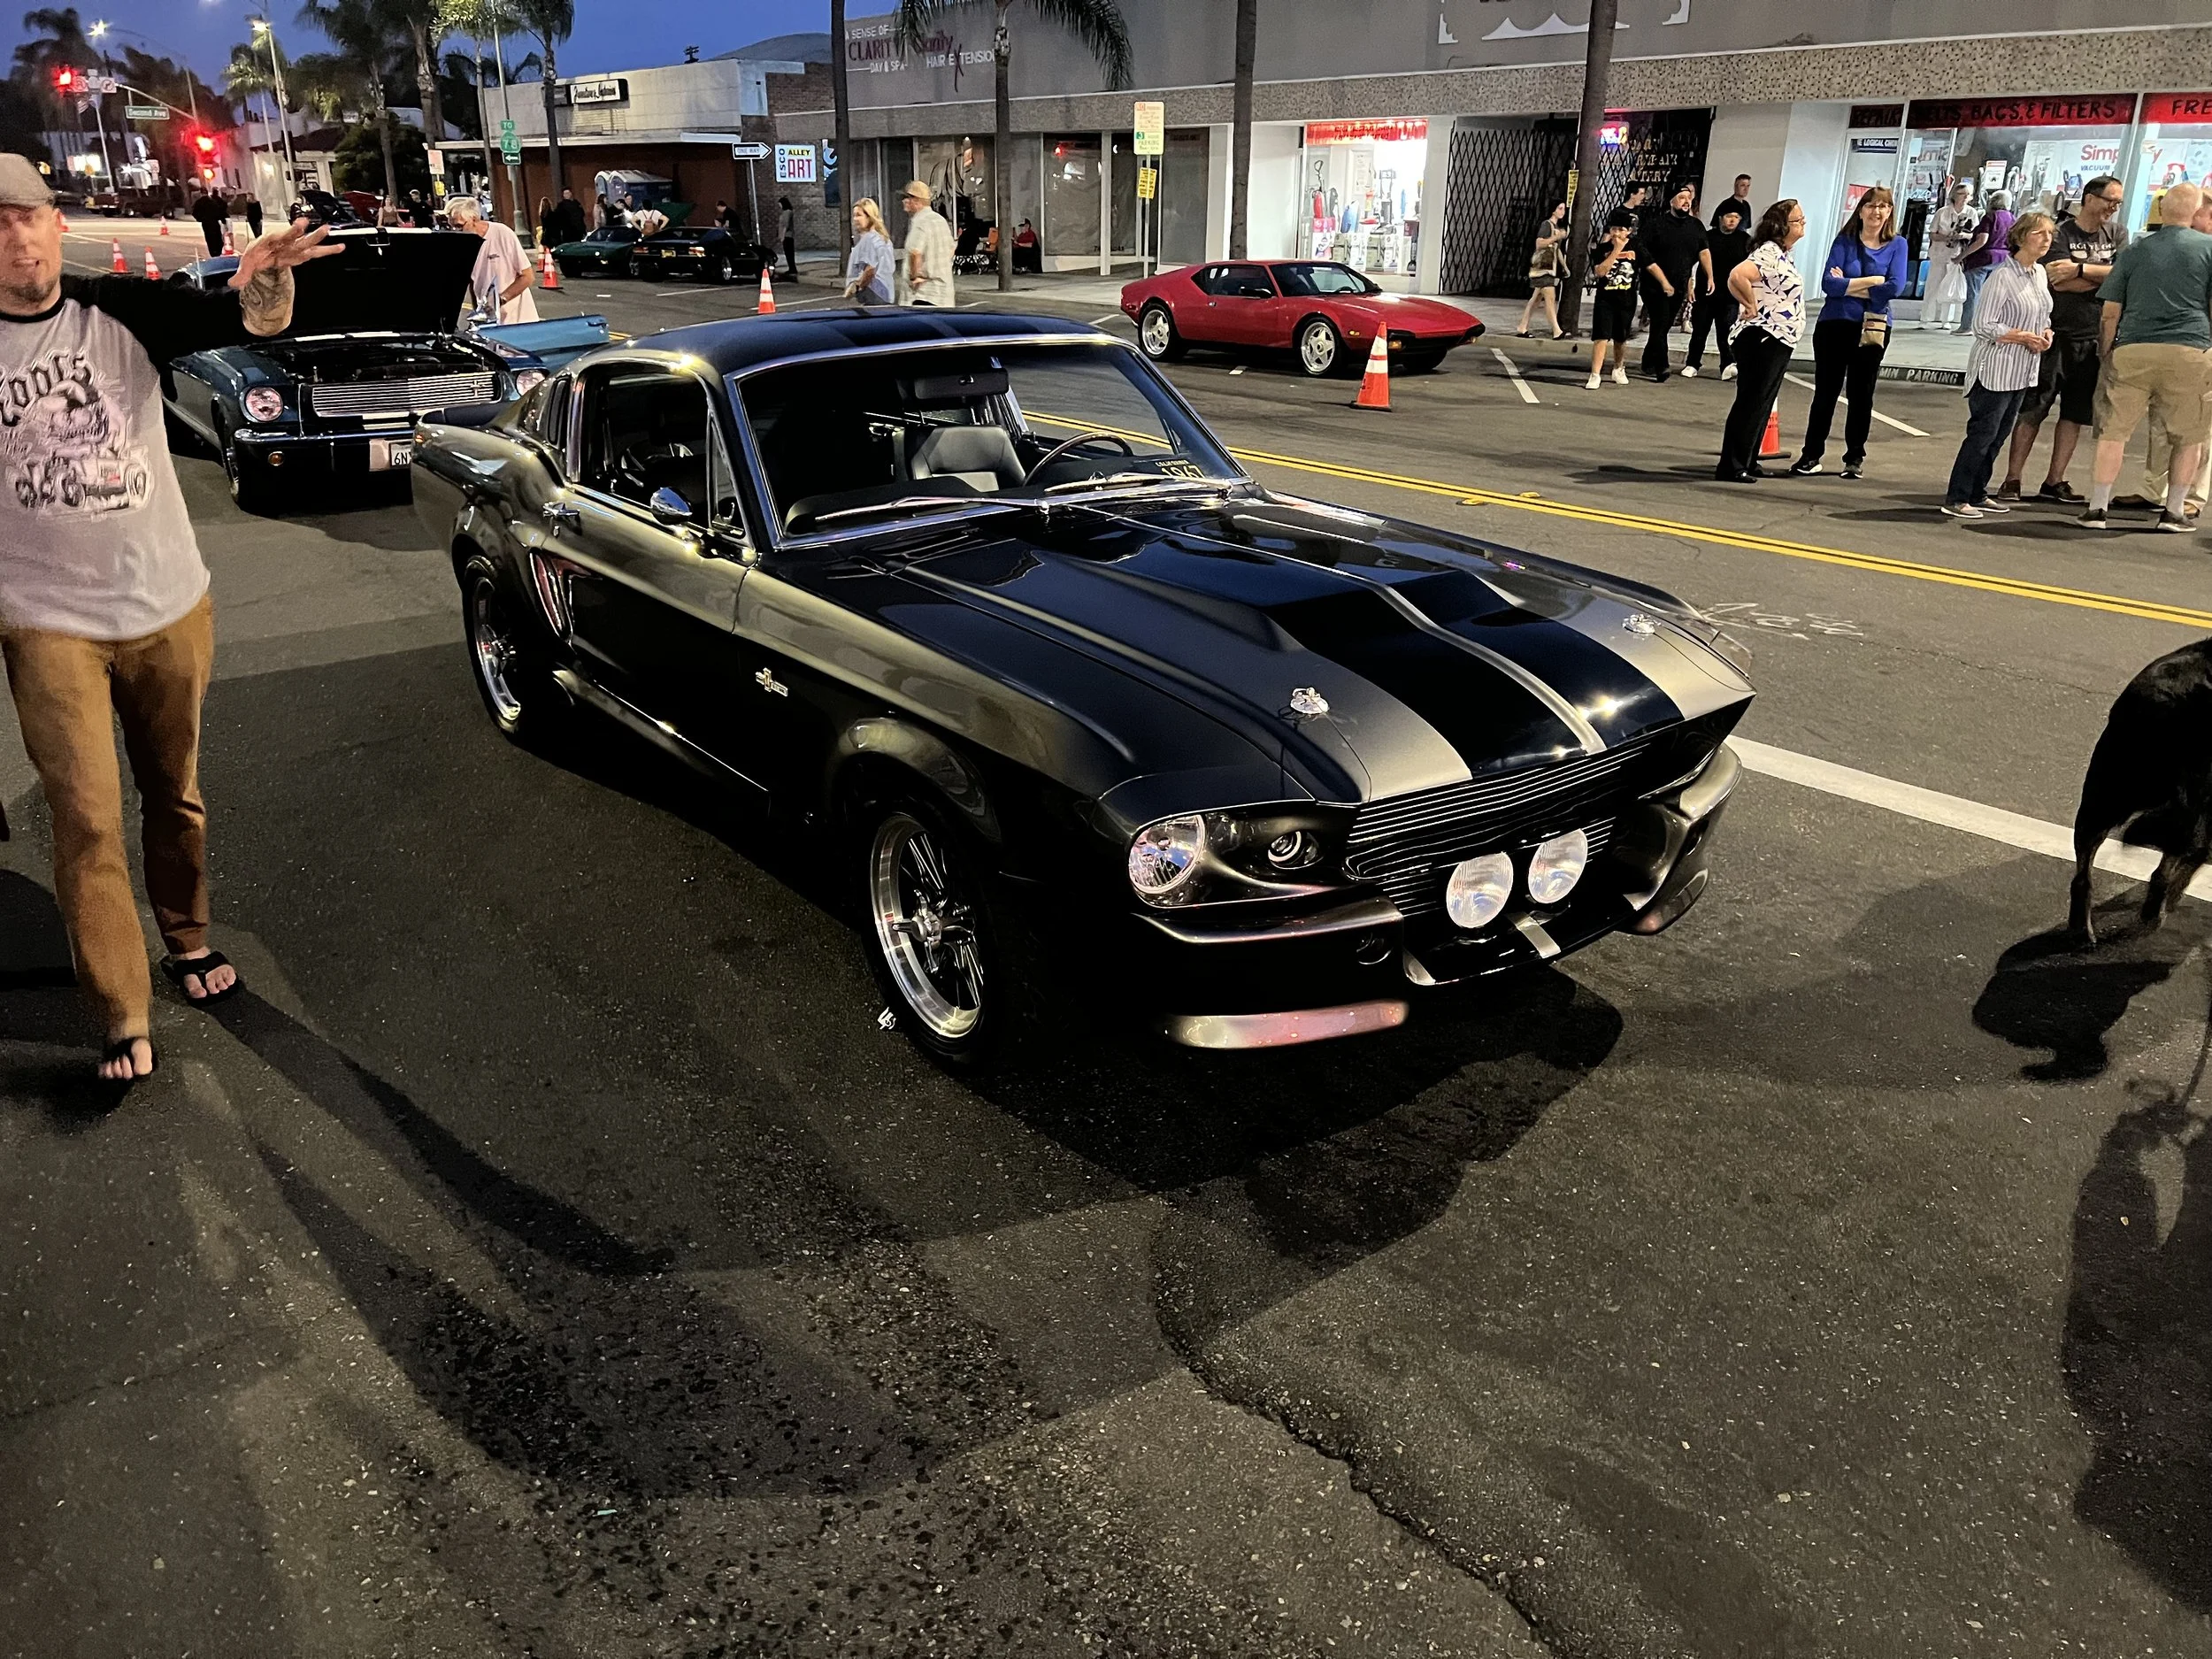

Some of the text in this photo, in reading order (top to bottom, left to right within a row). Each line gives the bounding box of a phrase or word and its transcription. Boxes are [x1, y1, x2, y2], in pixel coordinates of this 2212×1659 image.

[851, 27, 877, 40] SENSE
[879, 25, 889, 35] OF
[848, 37, 893, 61] CLARIT
[870, 62, 884, 73] DAY
[926, 54, 946, 68] HAIR
[2040, 100, 2116, 119] FILTERS
[503, 139, 518, 150] 78
[787, 159, 812, 179] ART
[1906, 369, 1959, 384] PARKING
[1161, 465, 1206, 479] 1967
